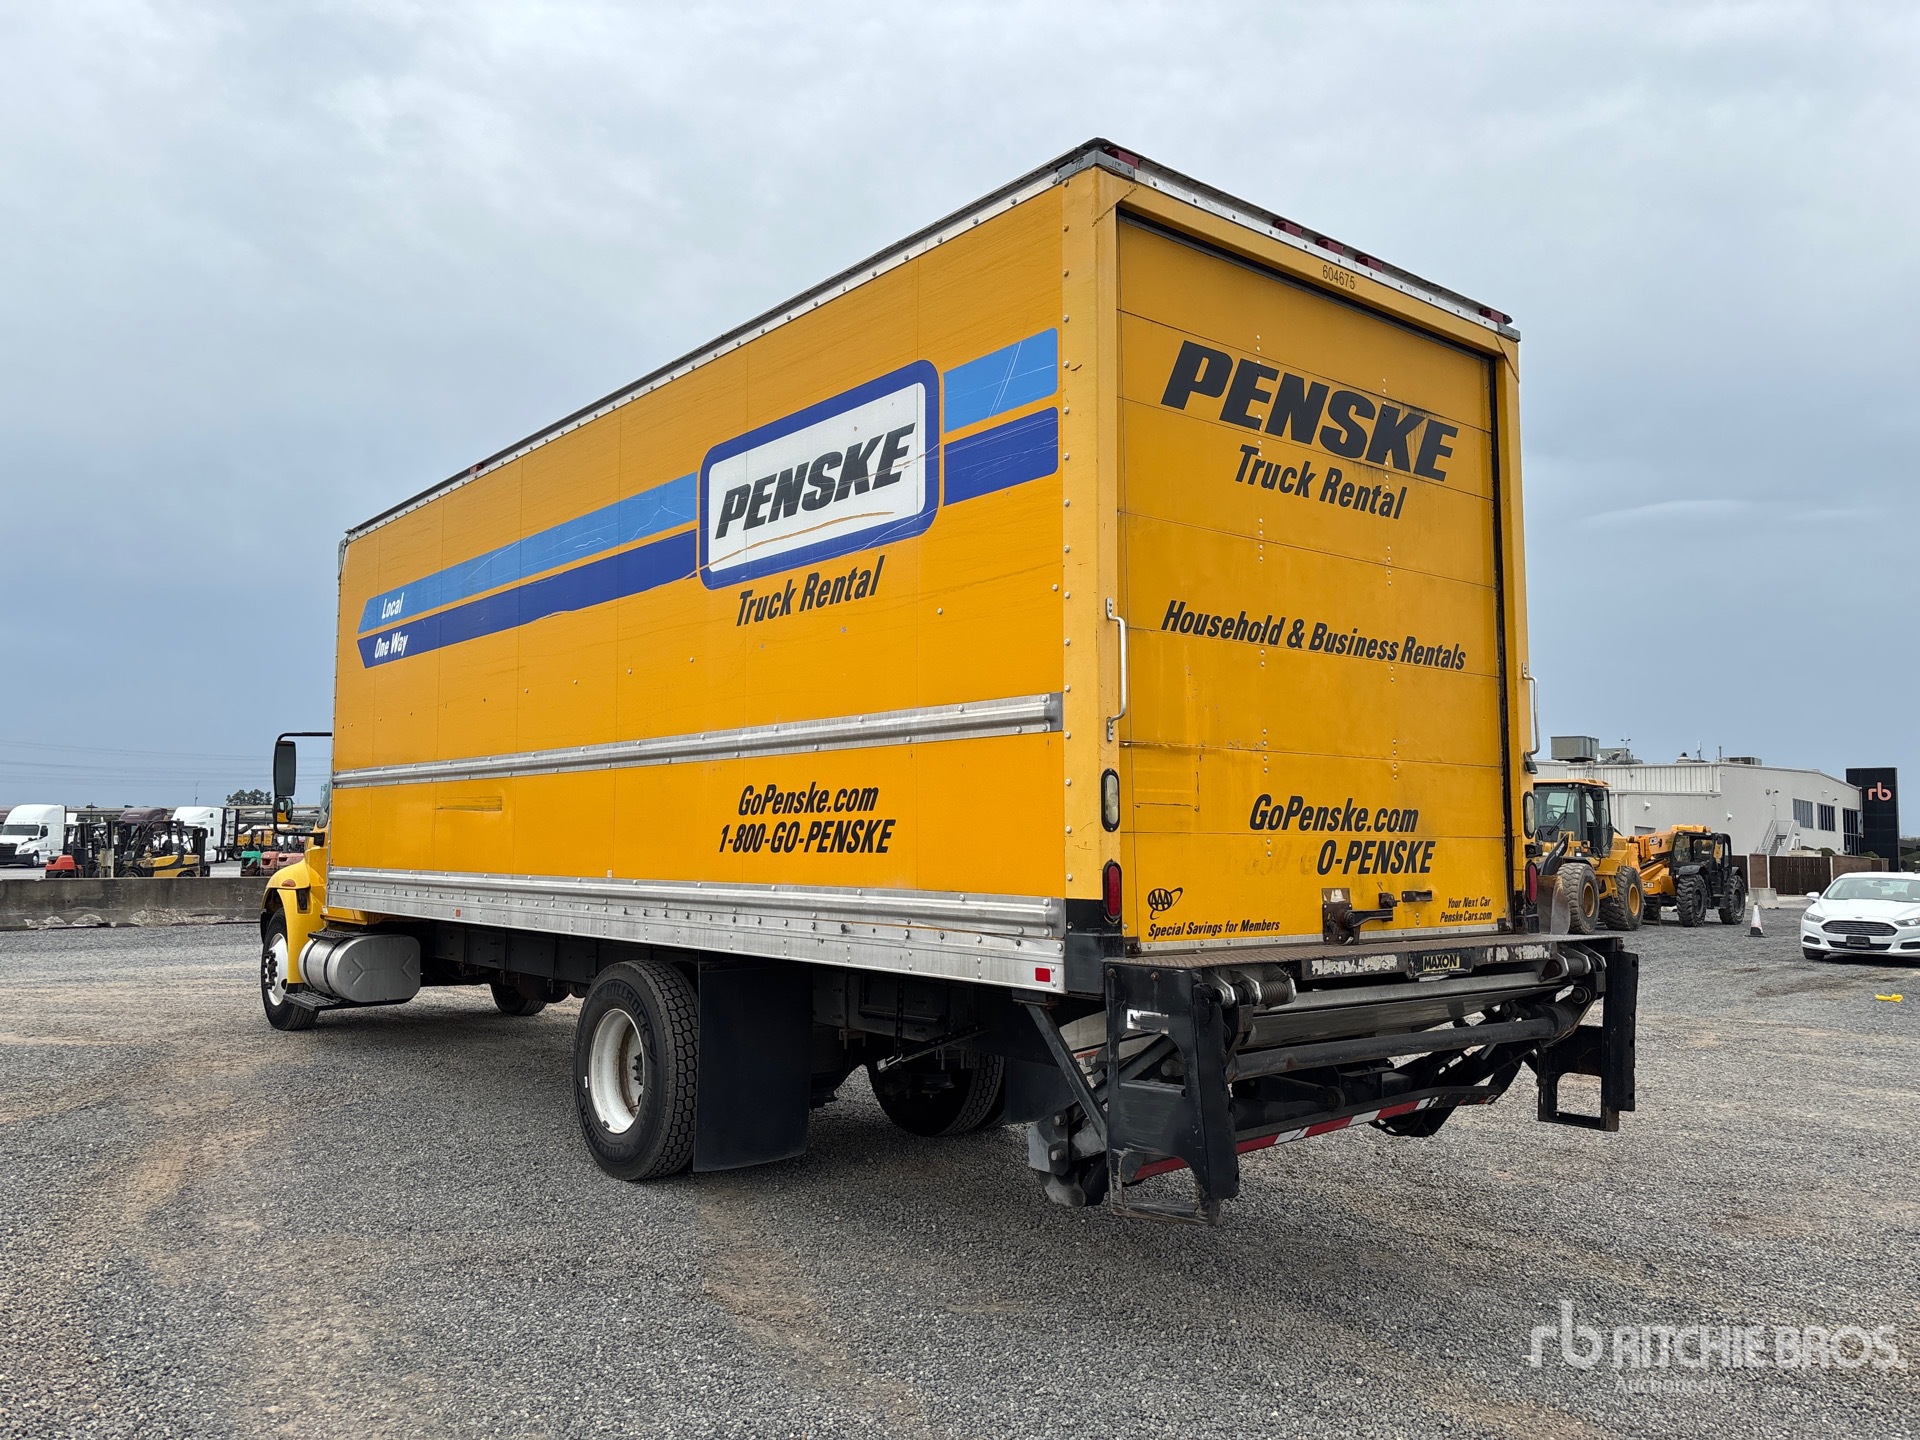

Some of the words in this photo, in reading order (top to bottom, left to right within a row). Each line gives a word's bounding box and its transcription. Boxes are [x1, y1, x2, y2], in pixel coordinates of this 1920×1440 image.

[1322, 264, 1356, 290] 604675
[1161, 340, 1459, 482] PENSKE
[716, 422, 915, 540] PENSKE
[1235, 444, 1316, 499] Truck
[1319, 467, 1408, 520] Rental
[381, 592, 405, 620] Local
[736, 579, 797, 627] Truck
[800, 555, 886, 612] Rental
[374, 637, 390, 659] One
[390, 631, 409, 656] Way
[1161, 599, 1287, 646] Household
[1286, 618, 1305, 649] &
[1308, 622, 1399, 661] Business
[1401, 635, 1467, 671] Rentals
[738, 781, 880, 816] GoPenske.com
[1867, 781, 1892, 801] rb
[1249, 793, 1419, 833] GoPenske.com
[719, 819, 896, 854] 1-800-GO-PENSKE
[1148, 888, 1173, 911] AAA
[1448, 898, 1461, 909] Your
[1462, 897, 1479, 908] Next
[1480, 896, 1491, 907] Car
[1149, 922, 1186, 940] Special
[1187, 920, 1223, 937] Savings
[1224, 920, 1239, 934] for
[1240, 918, 1281, 932] Members
[1423, 954, 1458, 970] MAXON
[607, 983, 650, 1036] HILLROCK
